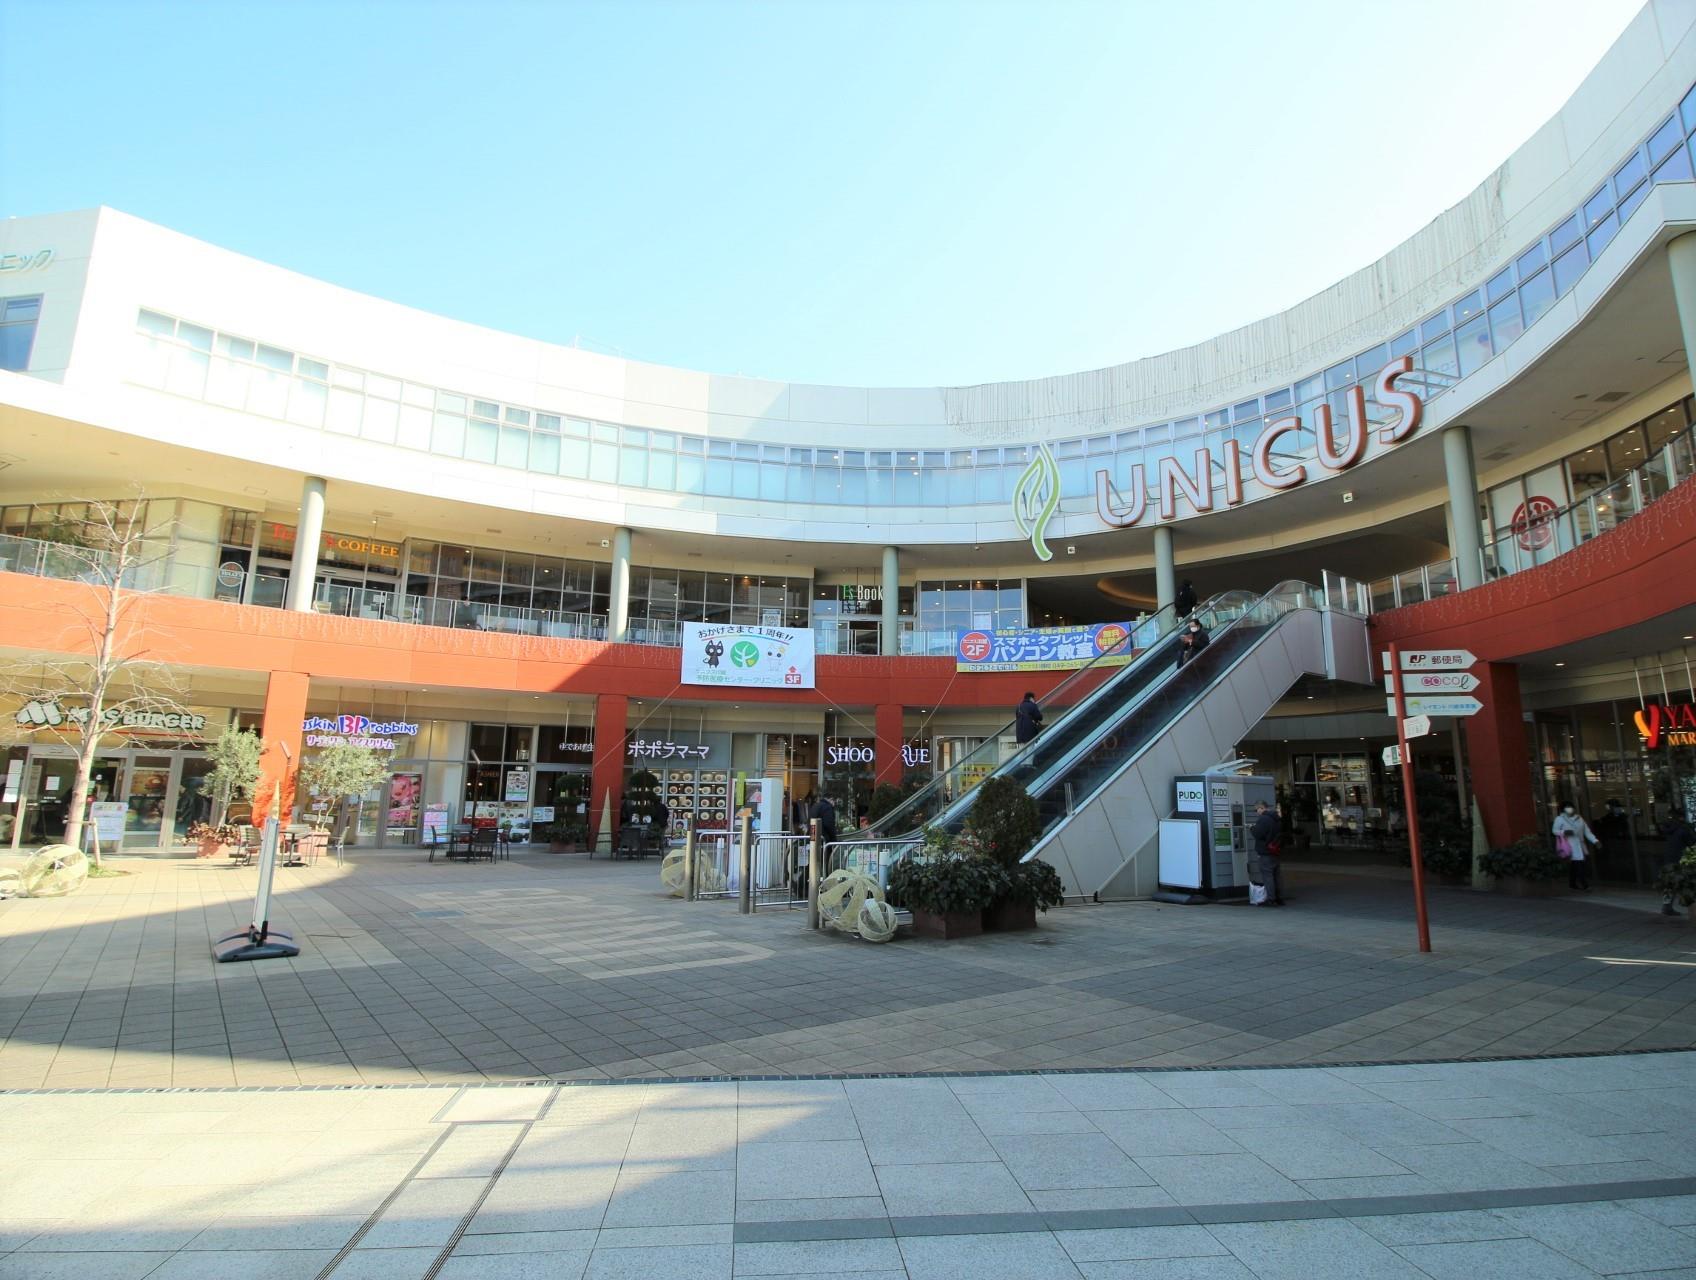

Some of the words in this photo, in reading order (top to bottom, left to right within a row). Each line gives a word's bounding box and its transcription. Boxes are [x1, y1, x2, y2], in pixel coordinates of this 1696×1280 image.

[1095, 355, 1422, 528] UNICUS
[338, 538, 399, 558] COFFEE
[993, 632, 1093, 647] スマホ・タブレット
[966, 644, 985, 656] 2F
[991, 642, 1094, 662] パソコン教室
[1431, 655, 1463, 665] 郵便局
[786, 674, 800, 684] 3F
[122, 711, 206, 731] BURGER
[369, 721, 418, 736] robbins
[627, 739, 711, 760] ポポラマーマ
[826, 746, 874, 765] SHOO
[1178, 791, 1203, 800] PUDO
[1212, 788, 1228, 797] PUDO
